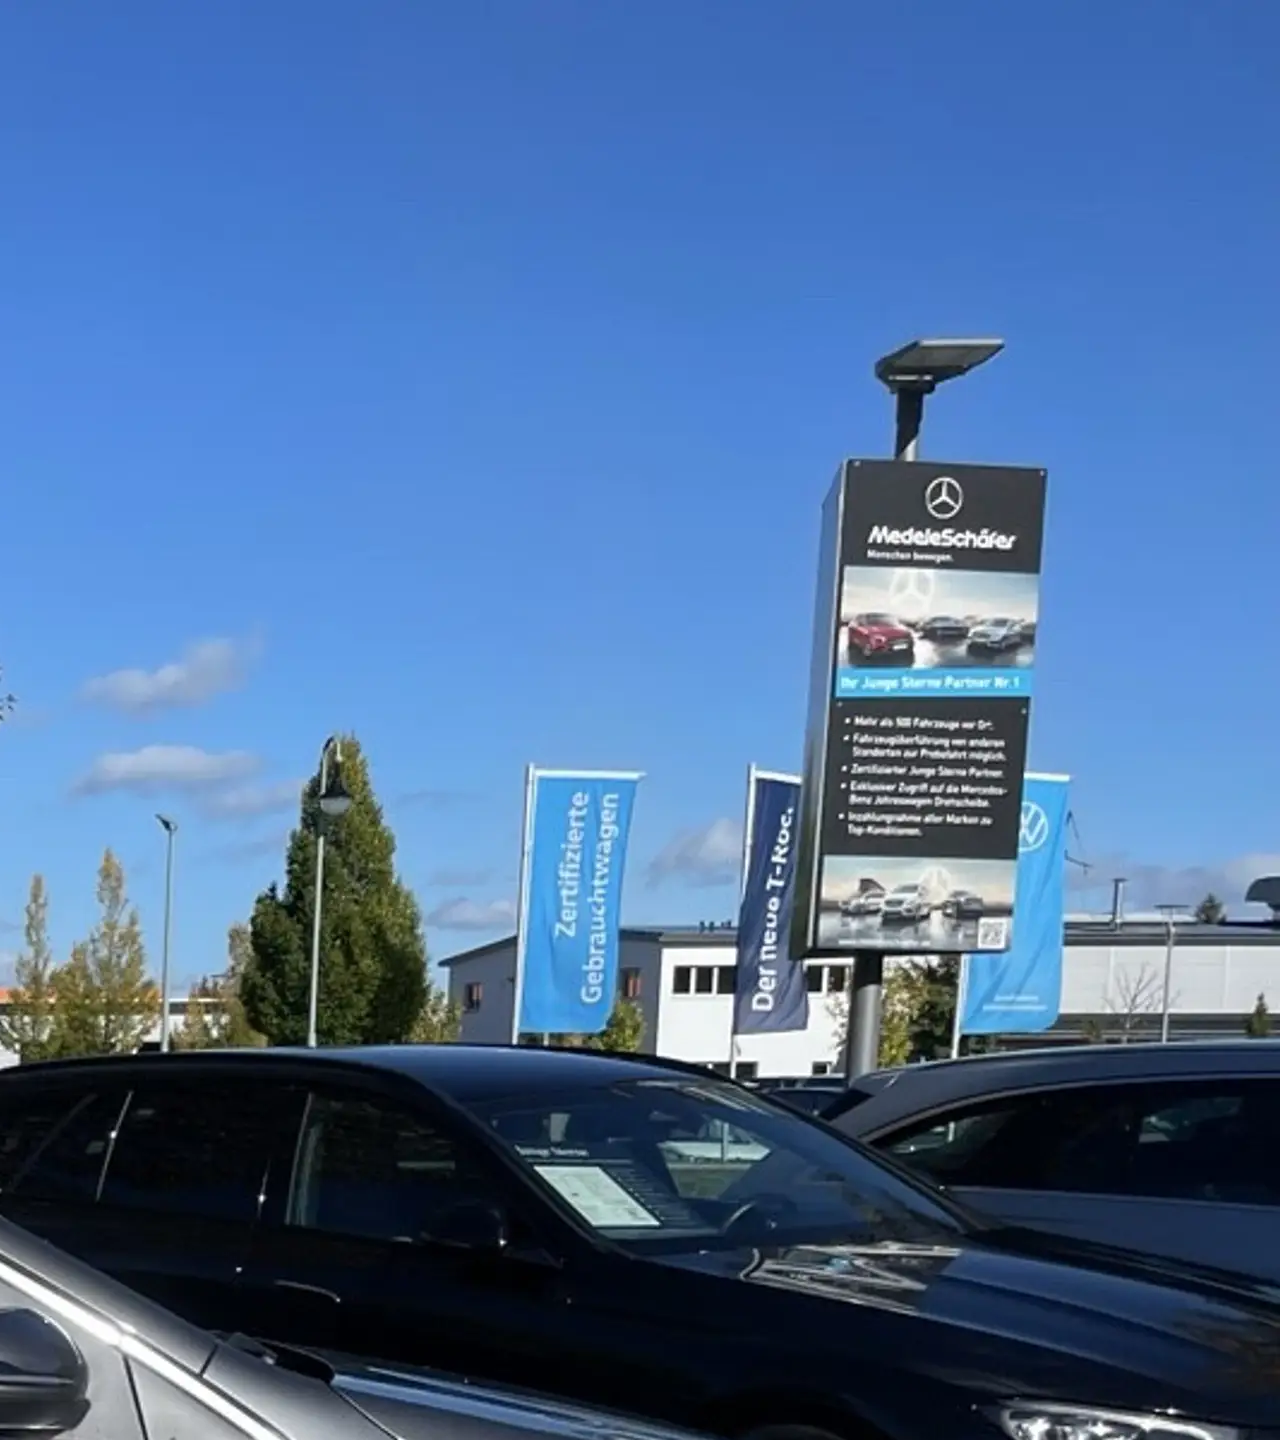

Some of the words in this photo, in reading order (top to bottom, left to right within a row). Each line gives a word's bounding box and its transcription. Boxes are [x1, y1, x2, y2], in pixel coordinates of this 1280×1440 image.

[867, 525, 1017, 550] MedeleSchäfer
[862, 677, 898, 691] Junge
[902, 677, 940, 689] Sterne
[944, 676, 990, 689] Partner
[913, 717, 959, 730] Fahrzeuge
[555, 791, 589, 938] Zertifizierte
[767, 806, 794, 892] T-Roc.
[580, 793, 619, 1003] Gebrauchtwagen
[760, 896, 781, 961] neue
[751, 966, 777, 1012] Der
